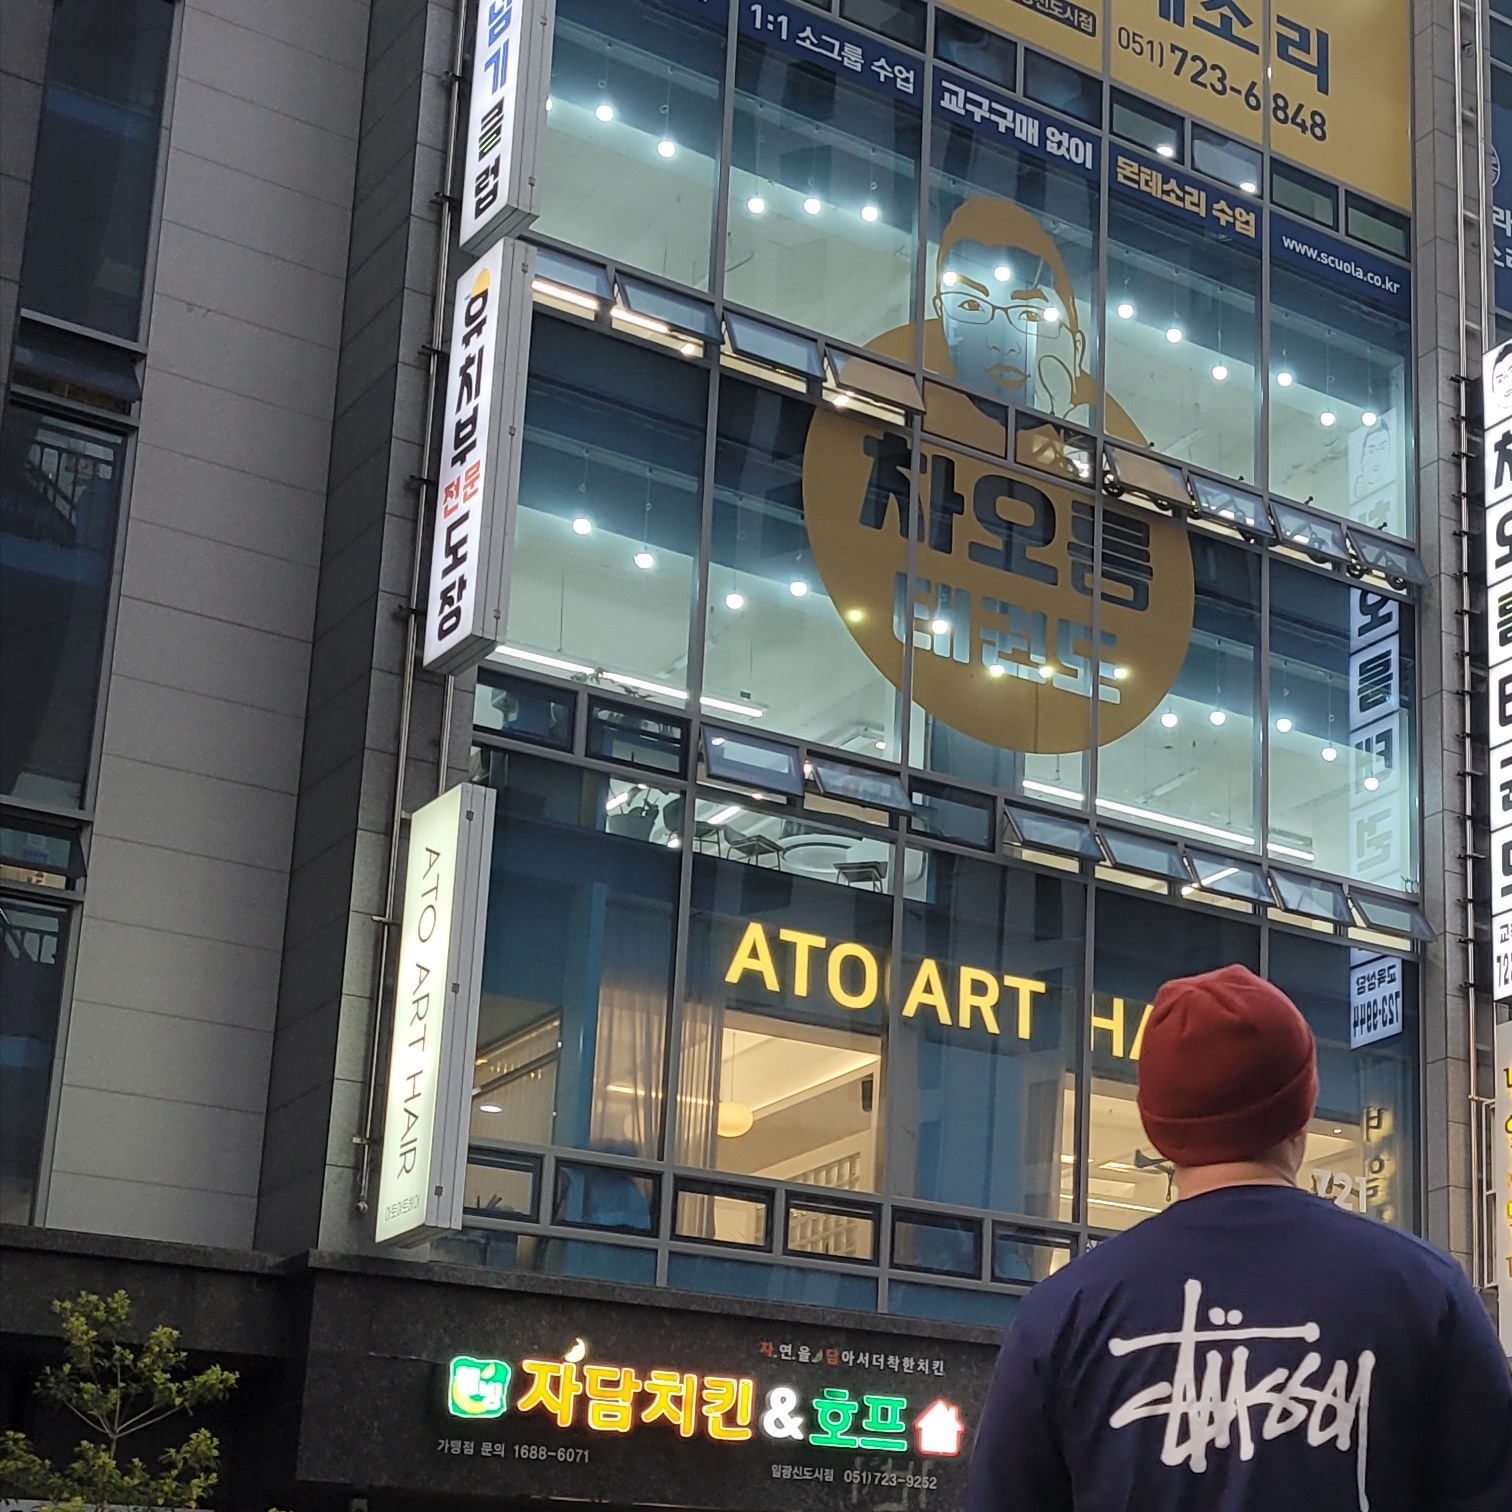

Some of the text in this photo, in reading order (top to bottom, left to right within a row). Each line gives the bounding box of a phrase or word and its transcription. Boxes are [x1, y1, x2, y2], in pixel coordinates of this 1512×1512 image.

[750, 4, 915, 95] 1:1 소그룹 수업
[940, 80, 1256, 239] 교구구매 없이 몬테소리 수업
[1282, 235, 1401, 295] www.scuola.co.kr
[451, 288, 488, 470] 유치부
[437, 510, 471, 642] 도장
[859, 431, 1154, 613] 차오름
[891, 571, 1122, 706] 태권도
[396, 846, 441, 1181] ATO ART HAIR
[725, 922, 1046, 1040] ATO ART
[480, 1441, 505, 1459] 문의
[513, 1444, 590, 1464] 1688-6071
[516, 1358, 908, 1453] 자담치킨 & 호프
